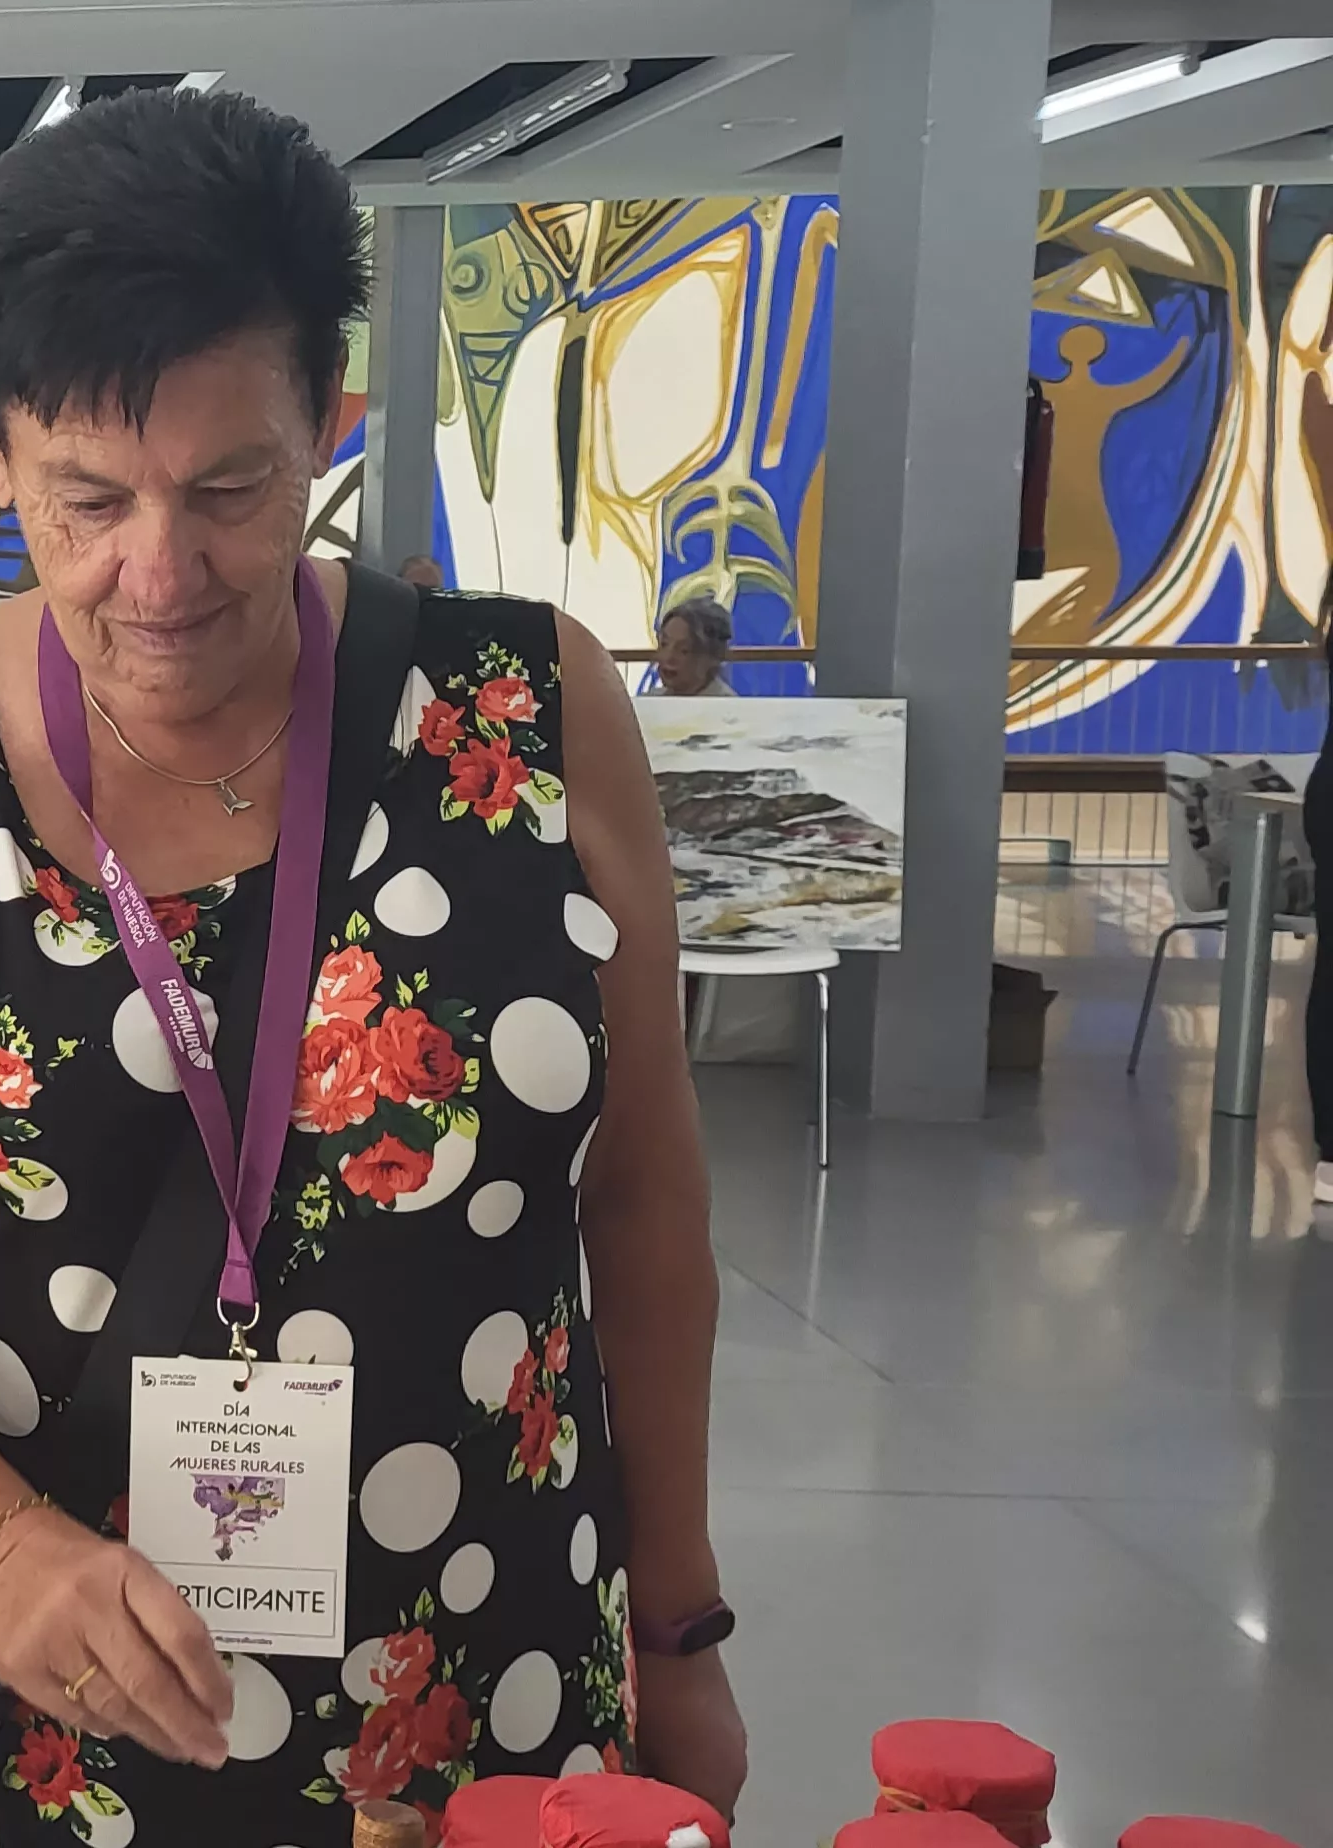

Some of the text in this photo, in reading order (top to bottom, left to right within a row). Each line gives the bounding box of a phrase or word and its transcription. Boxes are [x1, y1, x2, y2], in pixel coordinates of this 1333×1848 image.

[117, 890, 145, 949] DE HUESCA
[124, 880, 158, 943] DIPUTACIÓN
[160, 978, 201, 1049] FADEMUR
[283, 1380, 328, 1391] FADEMUR
[223, 1401, 250, 1417] DÍA
[175, 1421, 297, 1438] INTERNACIONAL
[210, 1440, 261, 1454] DE LAS
[169, 1457, 305, 1474] MUJERES RURALES
[176, 1584, 326, 1614] RTICIPANTE
